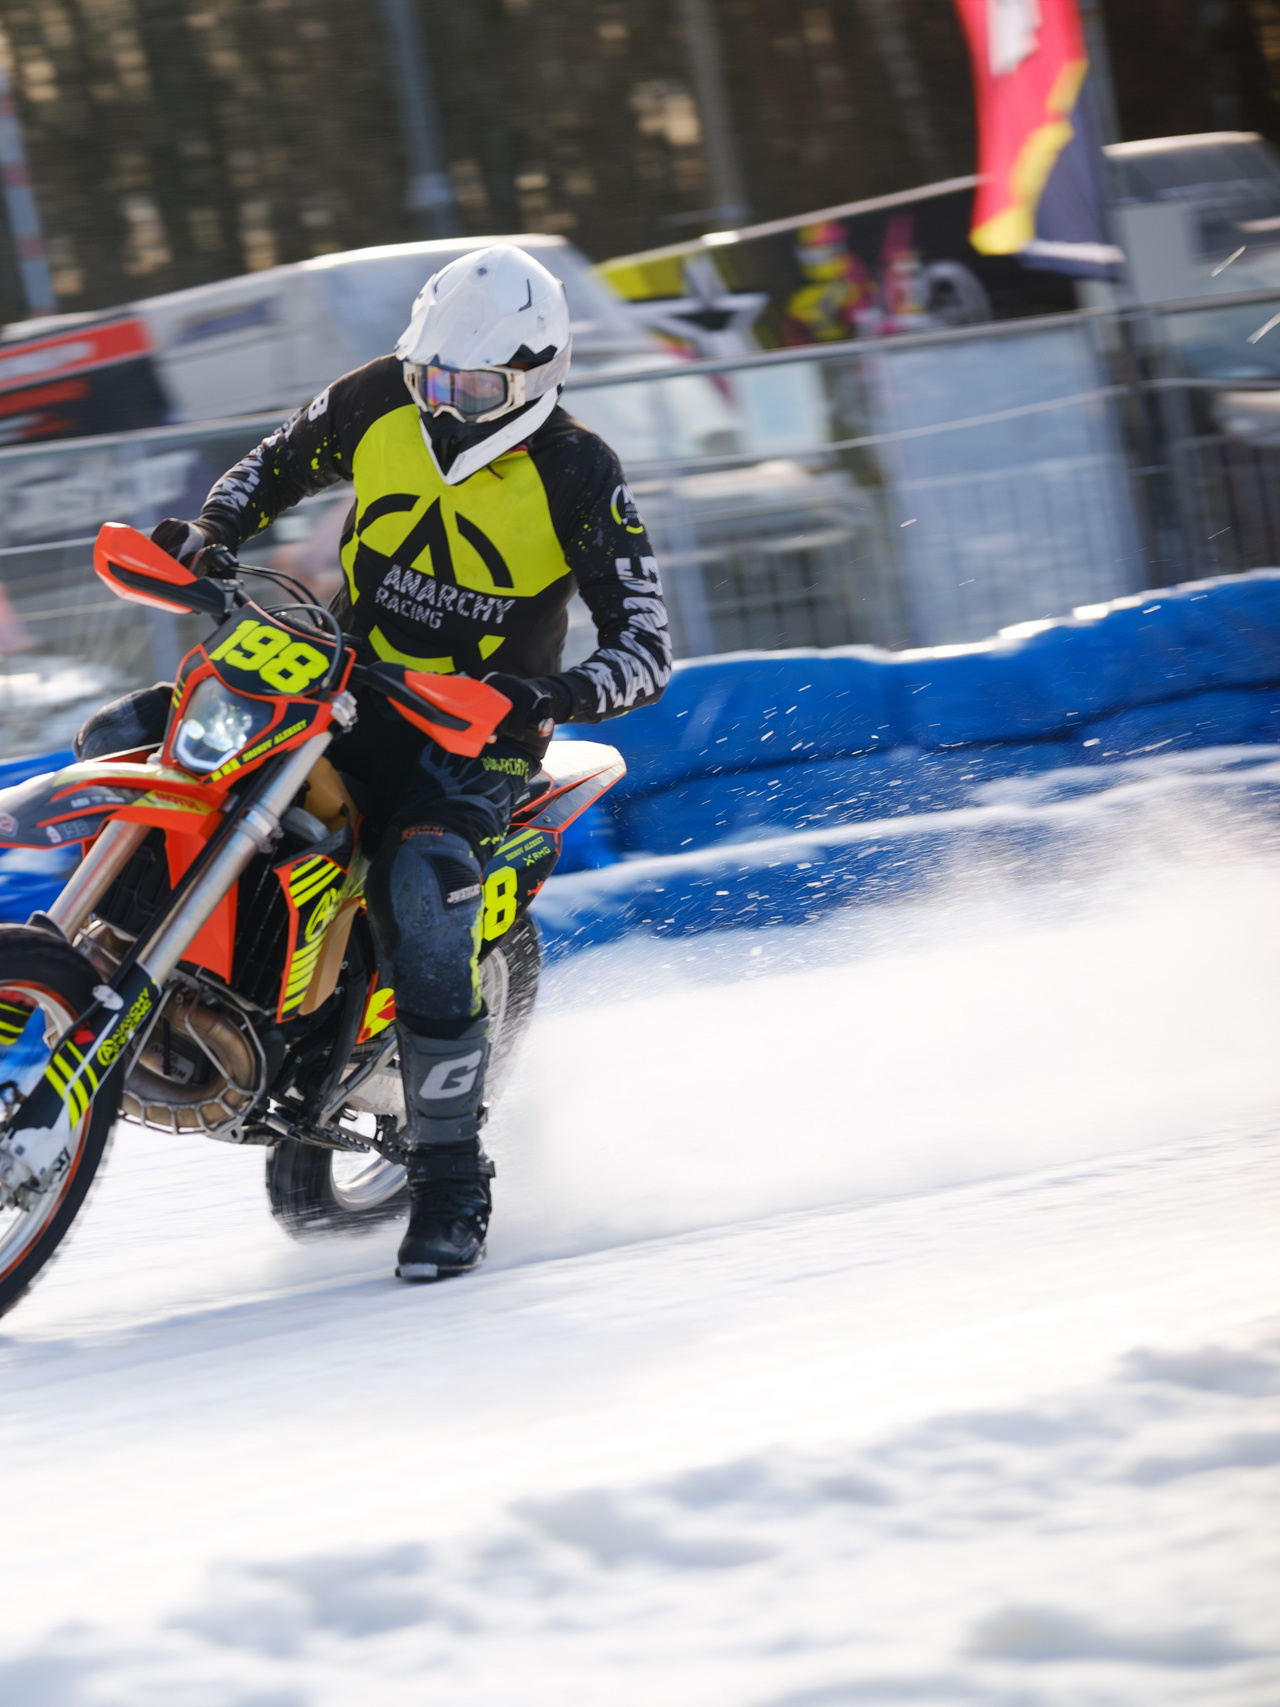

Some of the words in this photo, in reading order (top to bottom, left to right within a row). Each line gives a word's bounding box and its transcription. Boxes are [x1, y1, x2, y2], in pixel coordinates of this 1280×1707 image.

[375, 586, 444, 630] RACING
[382, 564, 516, 625] ANARCHY
[209, 619, 330, 695] 198
